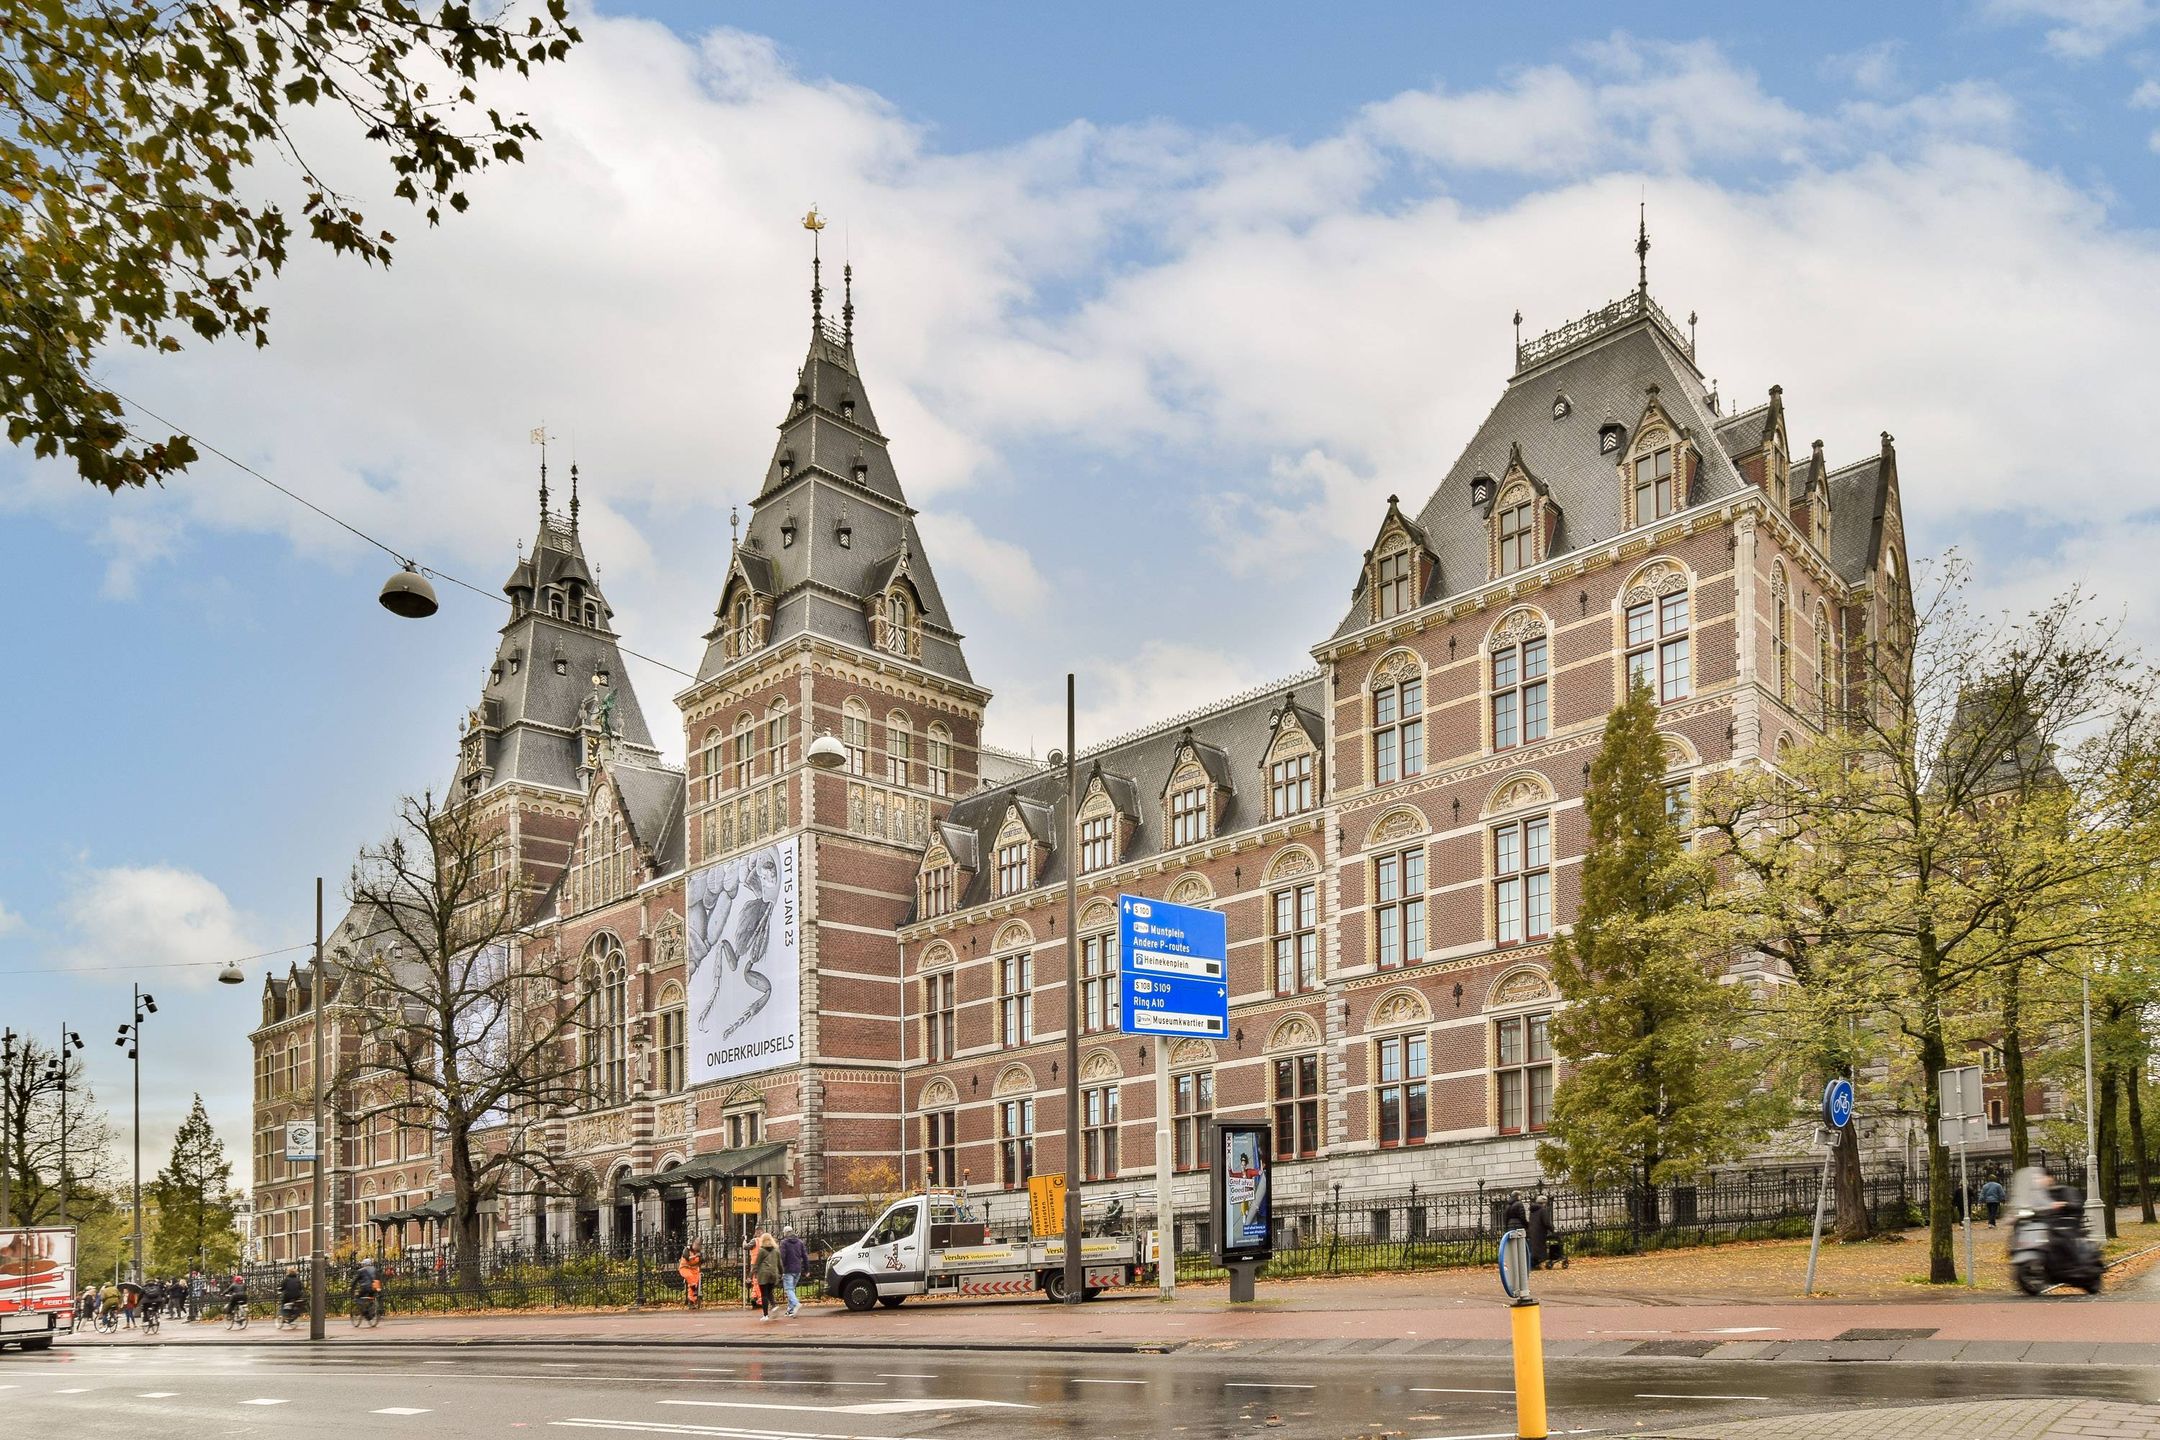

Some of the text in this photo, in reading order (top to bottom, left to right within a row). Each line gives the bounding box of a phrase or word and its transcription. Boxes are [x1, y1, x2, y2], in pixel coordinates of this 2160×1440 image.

[784, 847, 793, 947] TOT 15 JAN 23
[1151, 925, 1184, 939] Muntplein
[1133, 936, 1158, 949] Andere
[1144, 955, 1189, 969] Heinekenplein
[1154, 983, 1171, 993] S109
[1134, 996, 1165, 1009] Ring A10
[1153, 1016, 1204, 1027] Museumkwartier
[707, 1034, 794, 1067] ONDERKRUIPSELS
[1054, 1178, 1063, 1186] C
[733, 1195, 760, 1203] Omleiding
